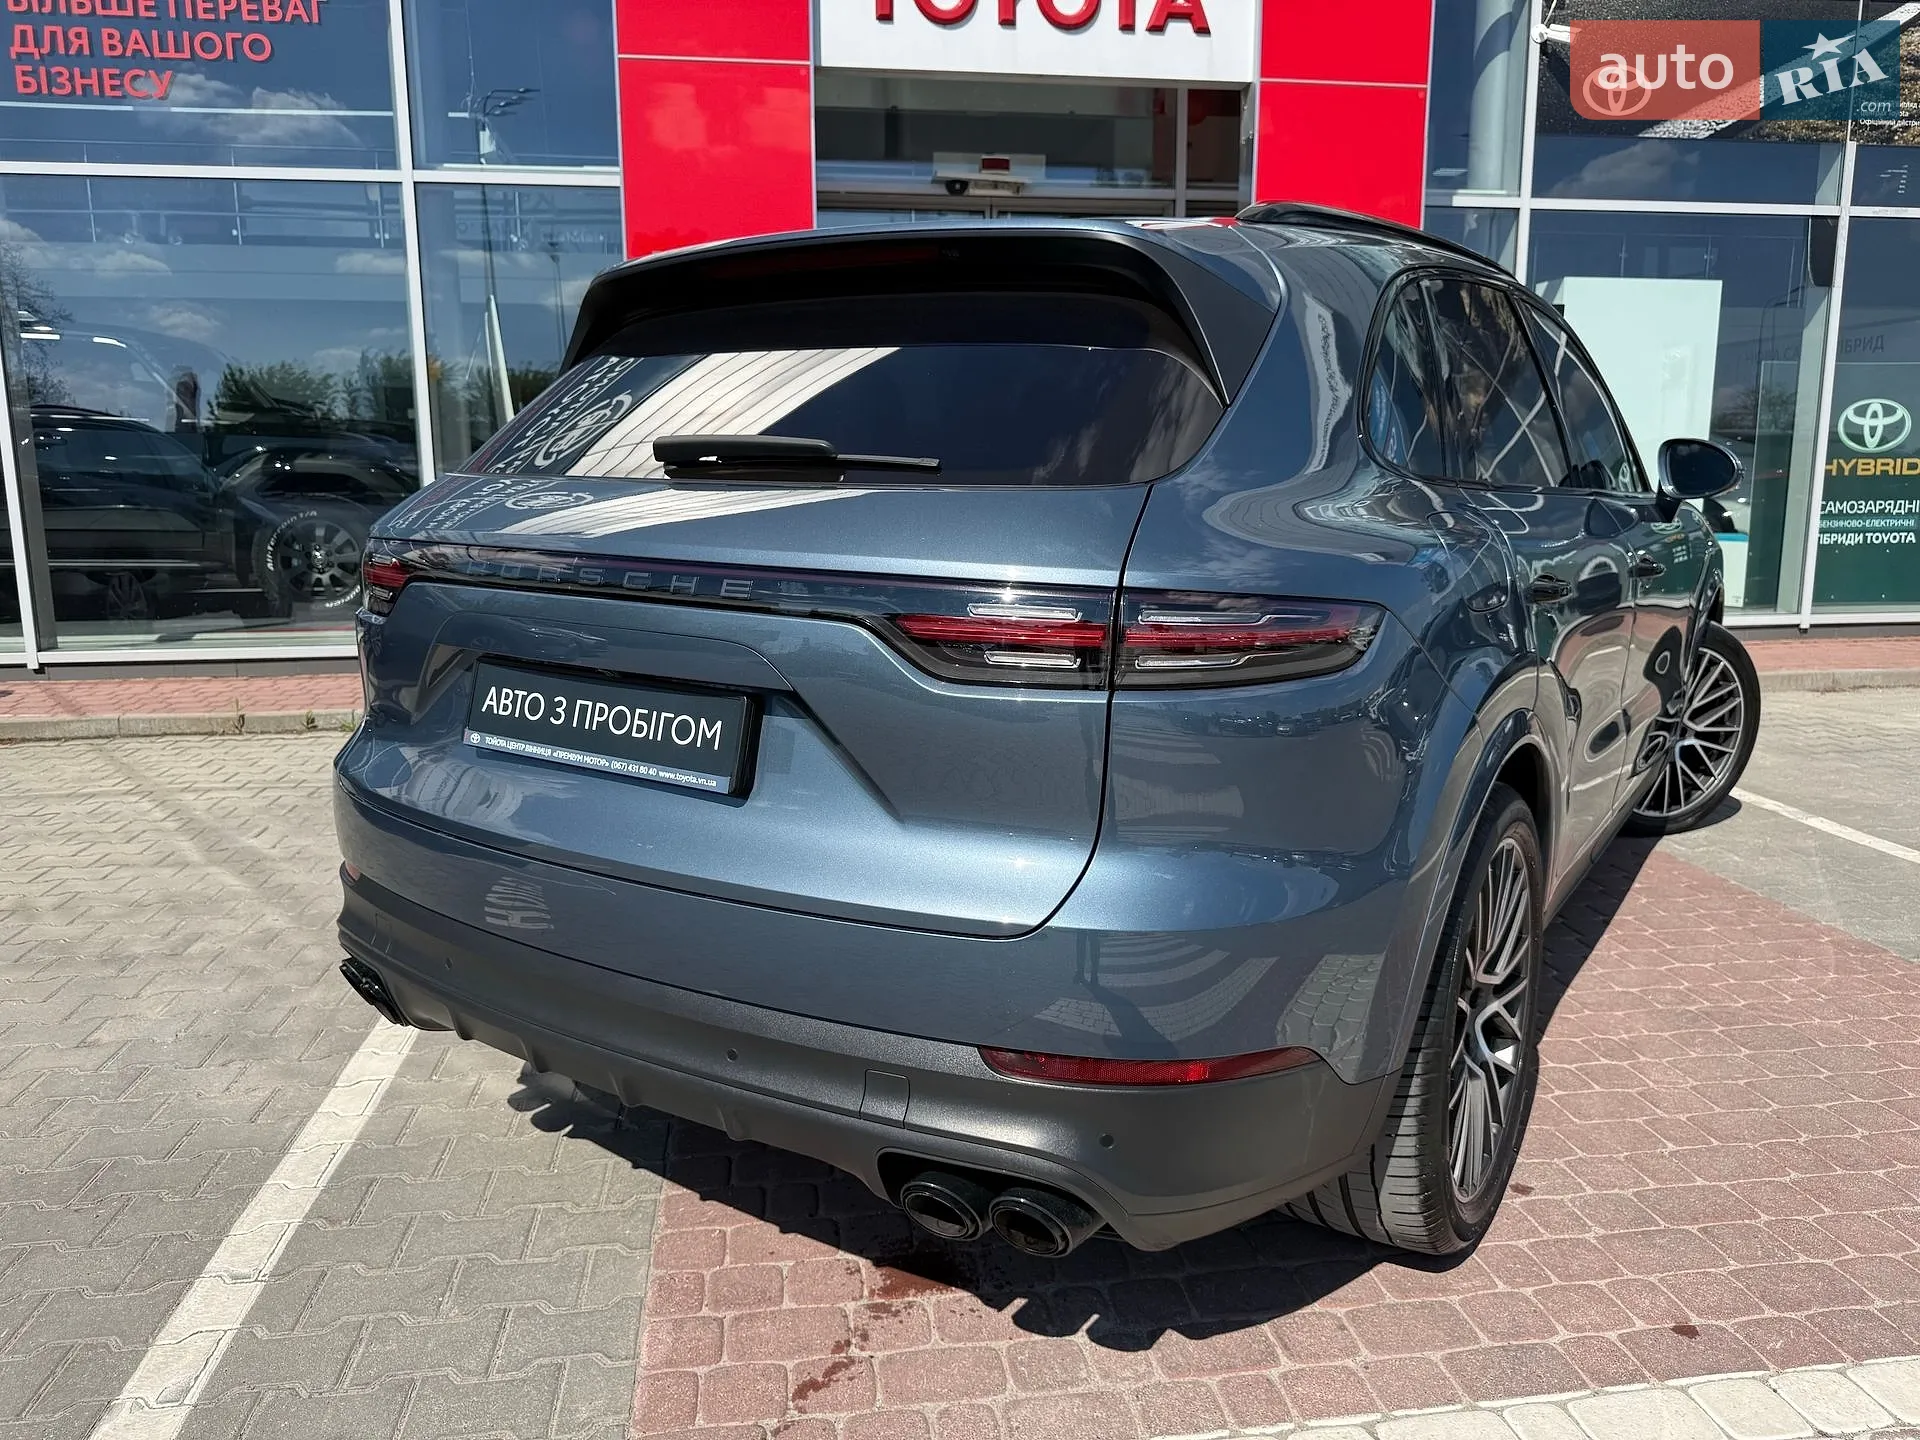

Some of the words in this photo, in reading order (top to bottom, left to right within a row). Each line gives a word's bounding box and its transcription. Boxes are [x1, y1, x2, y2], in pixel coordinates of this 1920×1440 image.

[10, 24, 91, 59] ДЛЯ
[101, 28, 272, 61] ВАШОГО
[15, 65, 173, 99] БІЗНЕСУ
[1838, 334, 1885, 354] ІБРИД
[1865, 531, 1916, 544] TOYOTA
[466, 559, 754, 600] PORSCHE
[481, 686, 545, 722] АВТО
[549, 695, 567, 726] З
[572, 699, 723, 750] ПРОБІГОМ
[628, 763, 639, 773] 431
[648, 767, 657, 776] 40
